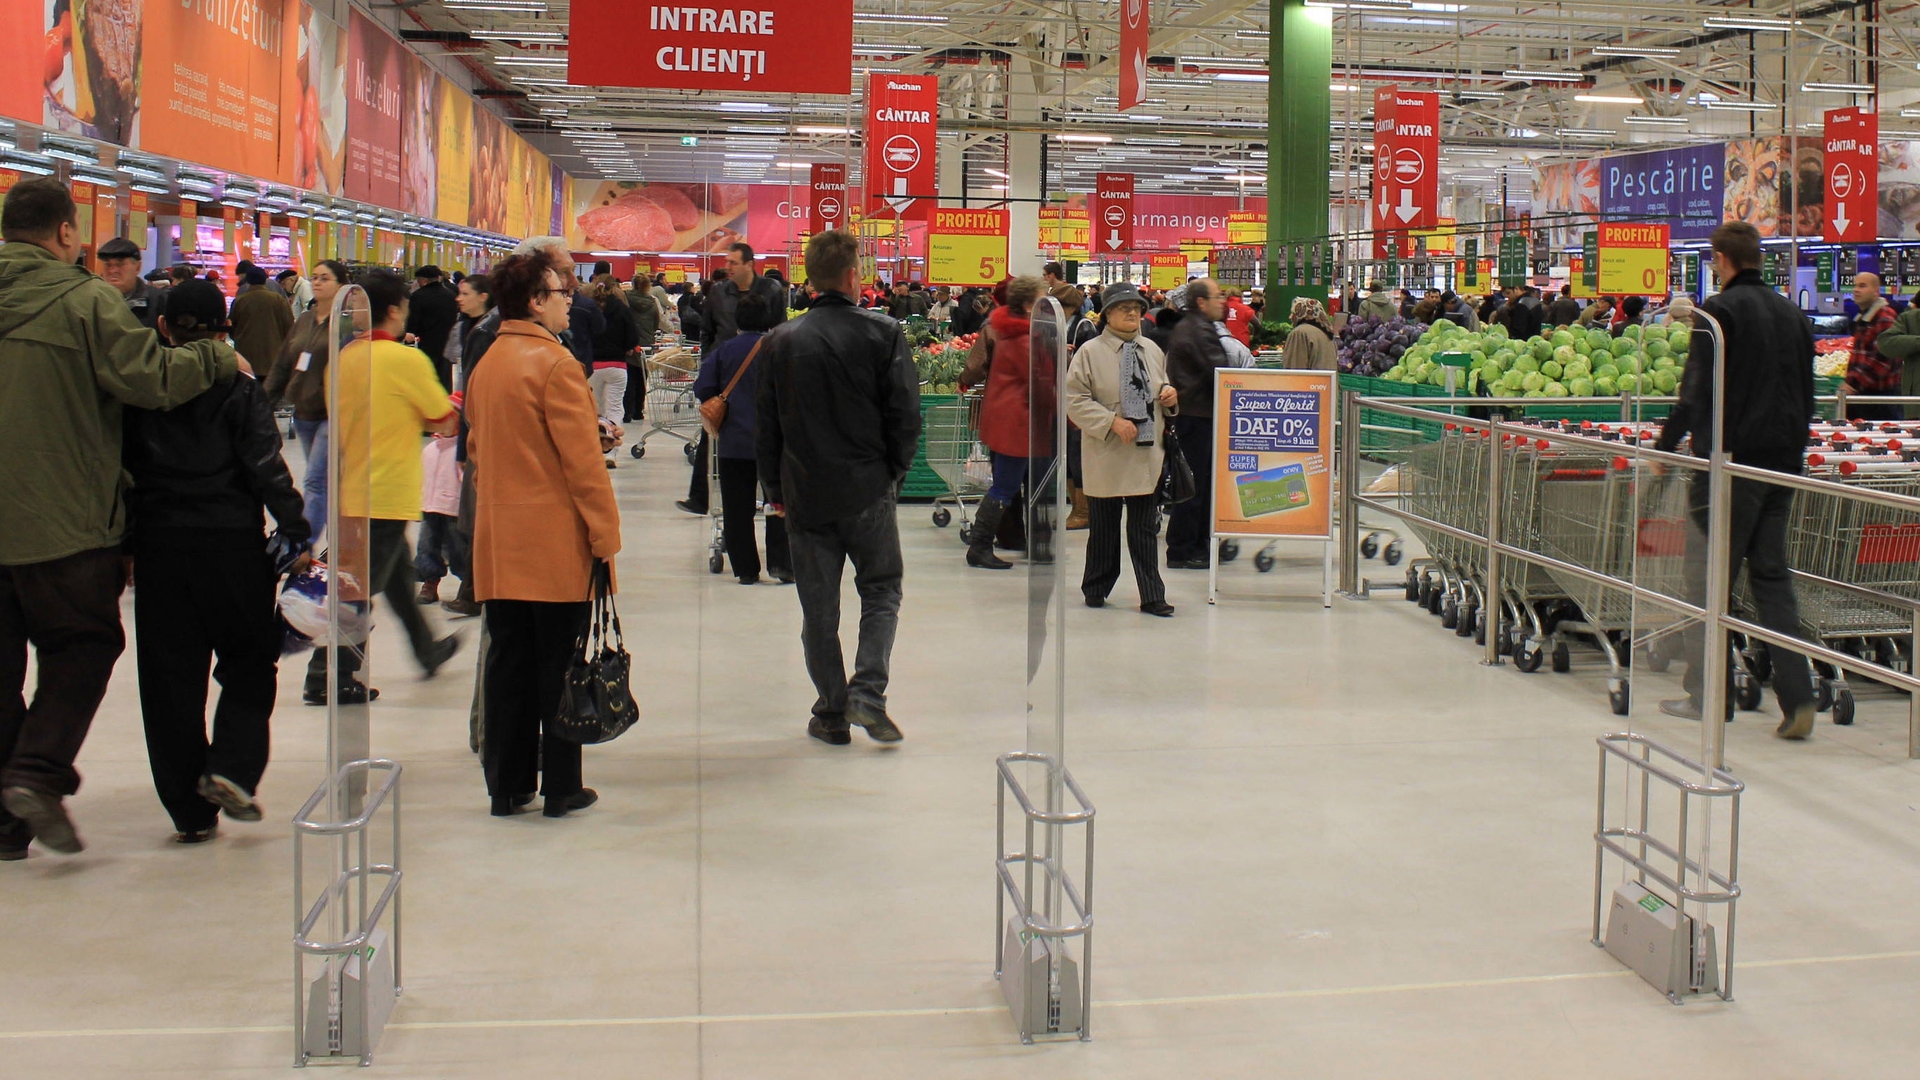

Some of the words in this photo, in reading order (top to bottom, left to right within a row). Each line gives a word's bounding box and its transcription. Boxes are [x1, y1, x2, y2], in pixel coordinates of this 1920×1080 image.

[650, 6, 774, 35] INTRARE
[181, 0, 282, 57] nzeturi
[656, 46, 765, 81] CLIENȚI
[356, 58, 400, 120] Mezeluri
[887, 81, 921, 91] Auchan
[876, 107, 930, 123] CÂNTAR
[1376, 118, 1395, 133] CÂNTAR
[1396, 124, 1432, 136] NTAR
[1827, 138, 1856, 152] CÂNTAR
[1610, 158, 1713, 198] Pescărie
[814, 182, 845, 190] CÂNTAR
[1101, 190, 1131, 199] CÂNTAR
[936, 211, 1000, 235] PROFITĂ!
[1133, 213, 1228, 232] armanger
[1606, 226, 1661, 248] PROFITĂ!
[980, 257, 995, 279] 5
[1154, 255, 1183, 267] PROFITĂ!
[1643, 268, 1656, 289] 0
[1841, 276, 1850, 285] 13
[1235, 397, 1271, 411] Super
[1275, 397, 1315, 412] Ofertă
[1235, 417, 1278, 435] DAE
[1283, 418, 1313, 436] 0%
[1299, 437, 1314, 445] luni
[1230, 455, 1256, 463] SUPER
[1283, 466, 1299, 474] oney
